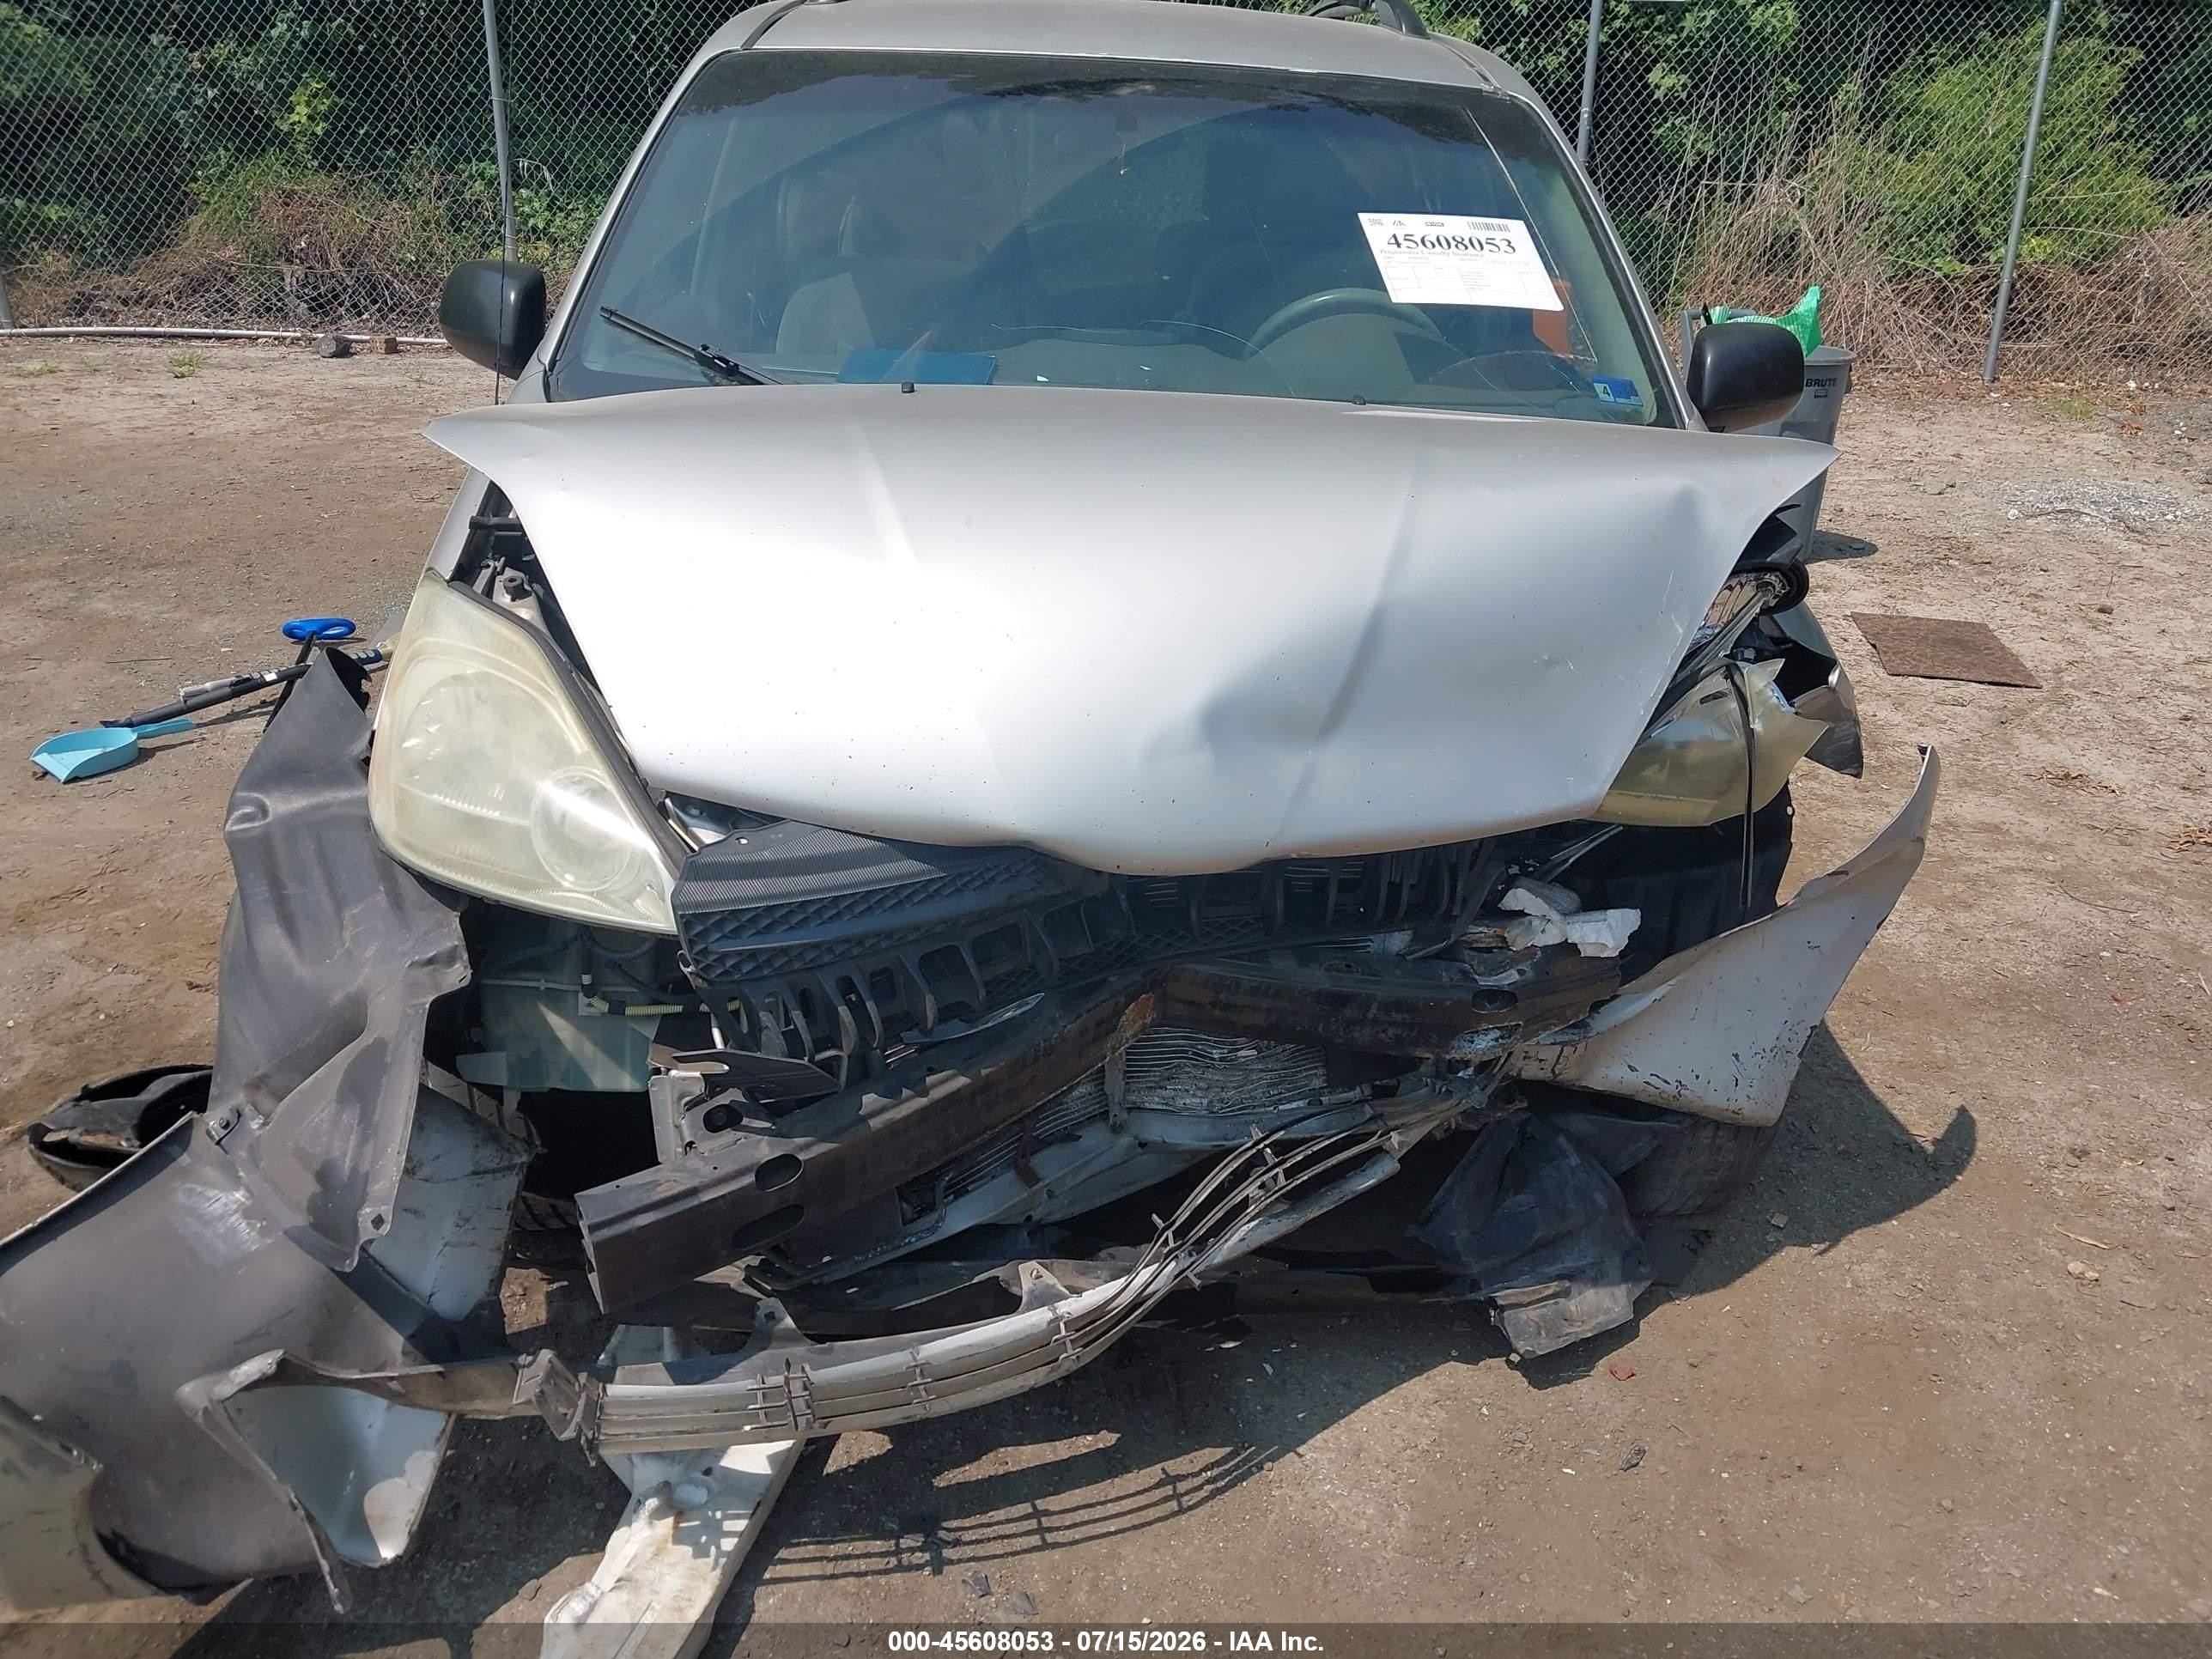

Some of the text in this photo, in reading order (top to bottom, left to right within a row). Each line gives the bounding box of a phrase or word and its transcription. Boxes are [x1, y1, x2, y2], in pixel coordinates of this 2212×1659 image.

[1387, 233, 1516, 255] 45608053
[1804, 378, 1838, 387] BRUTE
[1602, 385, 1611, 397] 4
